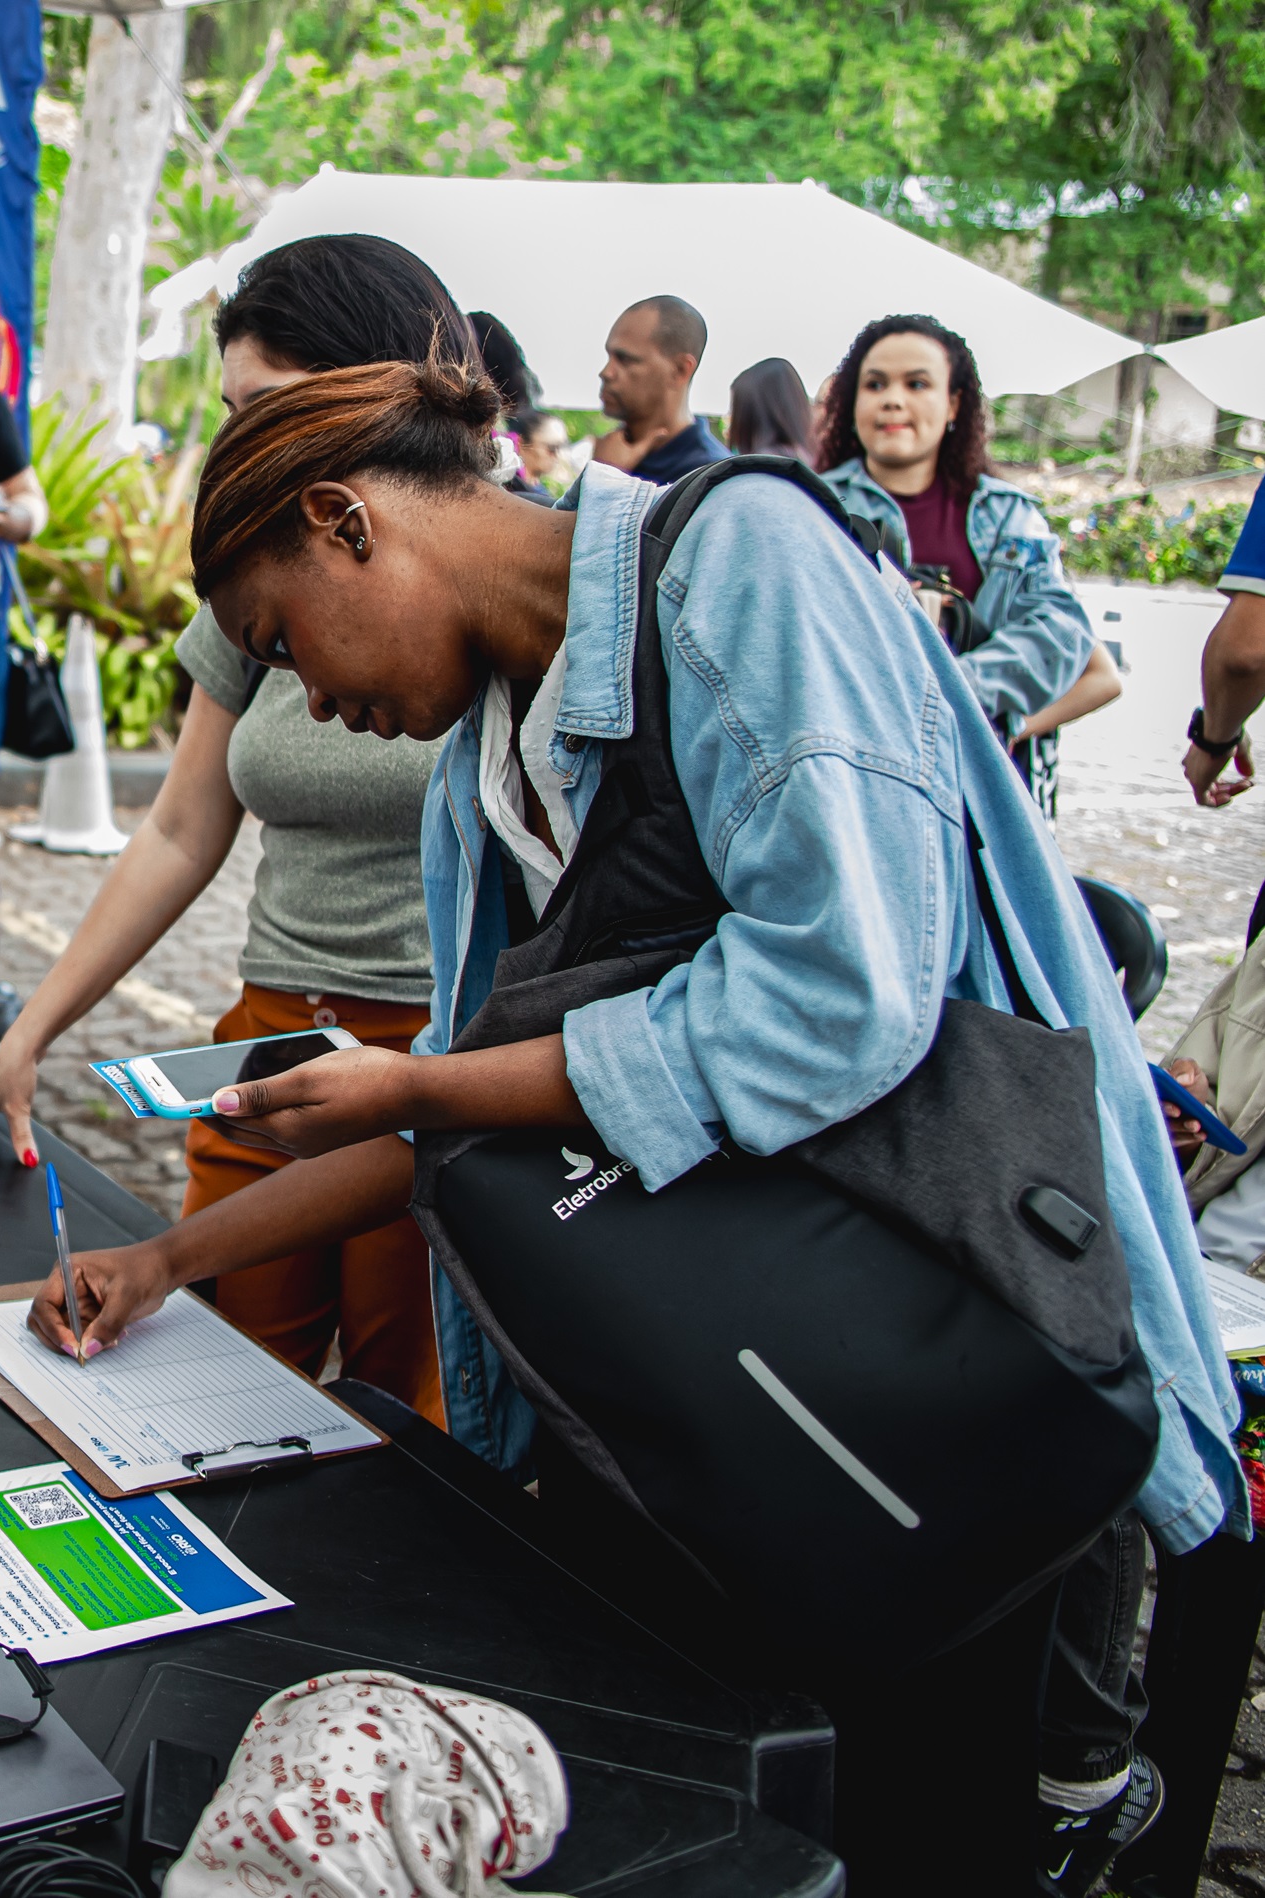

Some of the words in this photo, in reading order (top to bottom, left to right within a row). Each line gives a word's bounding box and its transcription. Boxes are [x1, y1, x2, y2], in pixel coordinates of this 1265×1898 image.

[552, 1160, 635, 1221] Eletrobra
[171, 1534, 191, 1549] RIO
[37, 1563, 68, 1593] funciona?
[6, 1591, 23, 1608] Inglês
[17, 1580, 41, 1605] culturais
[65, 1593, 84, 1611] Como
[9, 1618, 27, 1636] Vagas
[28, 1616, 45, 1632] Curso
[38, 1605, 62, 1630] Passeios
[1107, 1755, 1153, 1842] NIKE
